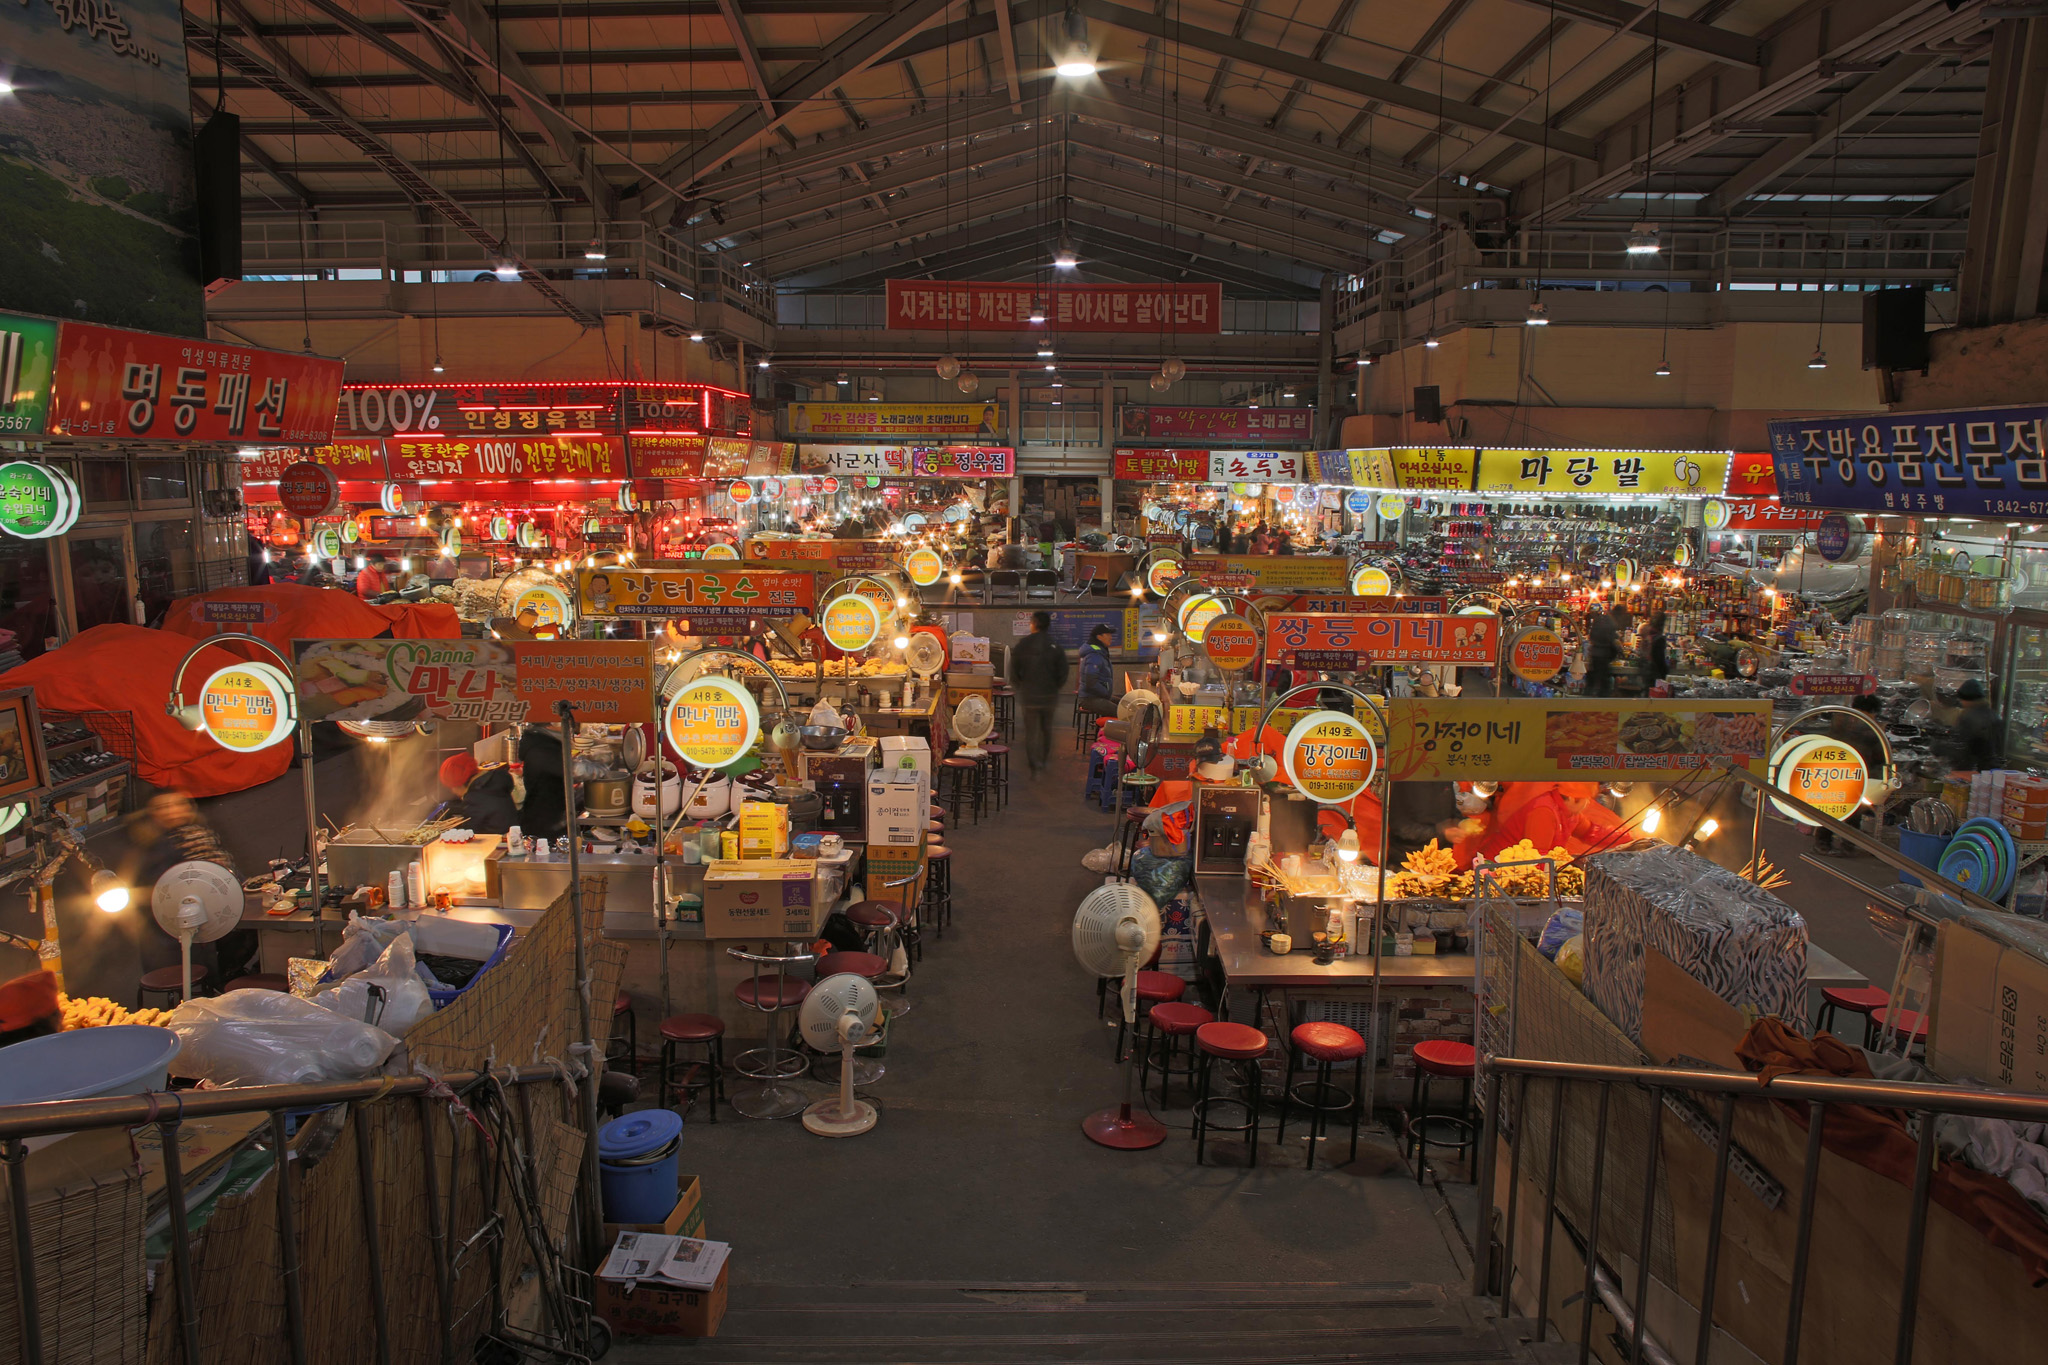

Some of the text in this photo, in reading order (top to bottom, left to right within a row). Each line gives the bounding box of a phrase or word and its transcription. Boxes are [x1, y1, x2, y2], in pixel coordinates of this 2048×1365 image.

[899, 289, 972, 322] 지켜보면
[1056, 292, 1129, 324] 돌아서면
[1134, 293, 1209, 325] 살아난다
[181, 346, 252, 371] 여성의류전문
[122, 361, 289, 438] 명동패션
[342, 388, 440, 432] 100%
[821, 412, 843, 424] 가수
[881, 414, 923, 425] 노래교실에
[926, 414, 969, 425] 초대합니다
[464, 409, 597, 430] 인성정육점
[1154, 410, 1307, 430] 가수 박인범 노래교실
[60, 417, 329, 442] 라-8-1호 T.848-6306
[1775, 432, 1797, 452] 혼수
[399, 443, 470, 459] 토종한우
[474, 442, 523, 475] 100%
[1799, 419, 2048, 484] 주방용품전문점
[826, 449, 906, 472] 사군자 떡
[923, 452, 1006, 474] 동호정육점
[1125, 458, 1201, 475] 토탈모아방
[1213, 457, 1224, 476] 즉석
[1228, 458, 1297, 478] 손두부
[1399, 462, 1468, 474] 어서오십시오.
[1519, 455, 1646, 488] 마당발
[283, 481, 328, 495] 명동패션
[1405, 476, 1463, 489] 감사합니다.
[1662, 485, 1707, 493] 842-1509
[1884, 491, 1945, 511] 협성주방
[2, 503, 46, 517] 수입코너
[622, 574, 760, 604] 장터국수
[768, 590, 797, 605] 전문
[691, 617, 714, 626] 아름답고
[735, 617, 747, 626] 시장
[696, 625, 743, 634] 어서오십시오
[1273, 617, 1443, 648] 쌍둥이네
[1209, 636, 1253, 652] 쌍둥이네
[1518, 643, 1561, 660] 쌍둥이네
[520, 655, 646, 669] 커피/냉커피/아이스티
[1297, 652, 1321, 660] 아름답고
[1342, 652, 1354, 660] 시장
[387, 643, 477, 693] Manna
[1302, 661, 1350, 670] 어서오십시오
[224, 677, 253, 689] 서4호
[407, 665, 502, 708] 만나
[520, 676, 646, 693] 감식초/쌍화차/생강차
[1806, 677, 1829, 685] 아름답고
[1849, 677, 1861, 685] 시장
[1810, 685, 1856, 694] 어서오십시오
[206, 692, 274, 716] 만나김밥
[692, 691, 724, 702] 서8호
[447, 700, 531, 722] 꼬마김밥
[550, 700, 620, 714] 율차/마차
[676, 704, 741, 728] 만나김밥
[218, 730, 265, 741] 010-5478-1305
[1316, 726, 1353, 738] 서49호
[1414, 720, 1521, 753] 강정이네
[686, 747, 734, 756] 010-5478-1305
[1299, 743, 1368, 767] 강정이네
[1445, 753, 1493, 767] 분식 전문
[1811, 750, 1848, 762] 서45호
[1569, 755, 1614, 770] 쌀떡볶이
[1624, 755, 1669, 770] 찹쌀순대
[1308, 781, 1354, 791] 019-311-6116
[1795, 767, 1863, 789] 강정이네
[728, 907, 771, 917] 동원선물세트
[1999, 1010, 2017, 1085] 금호경금속
